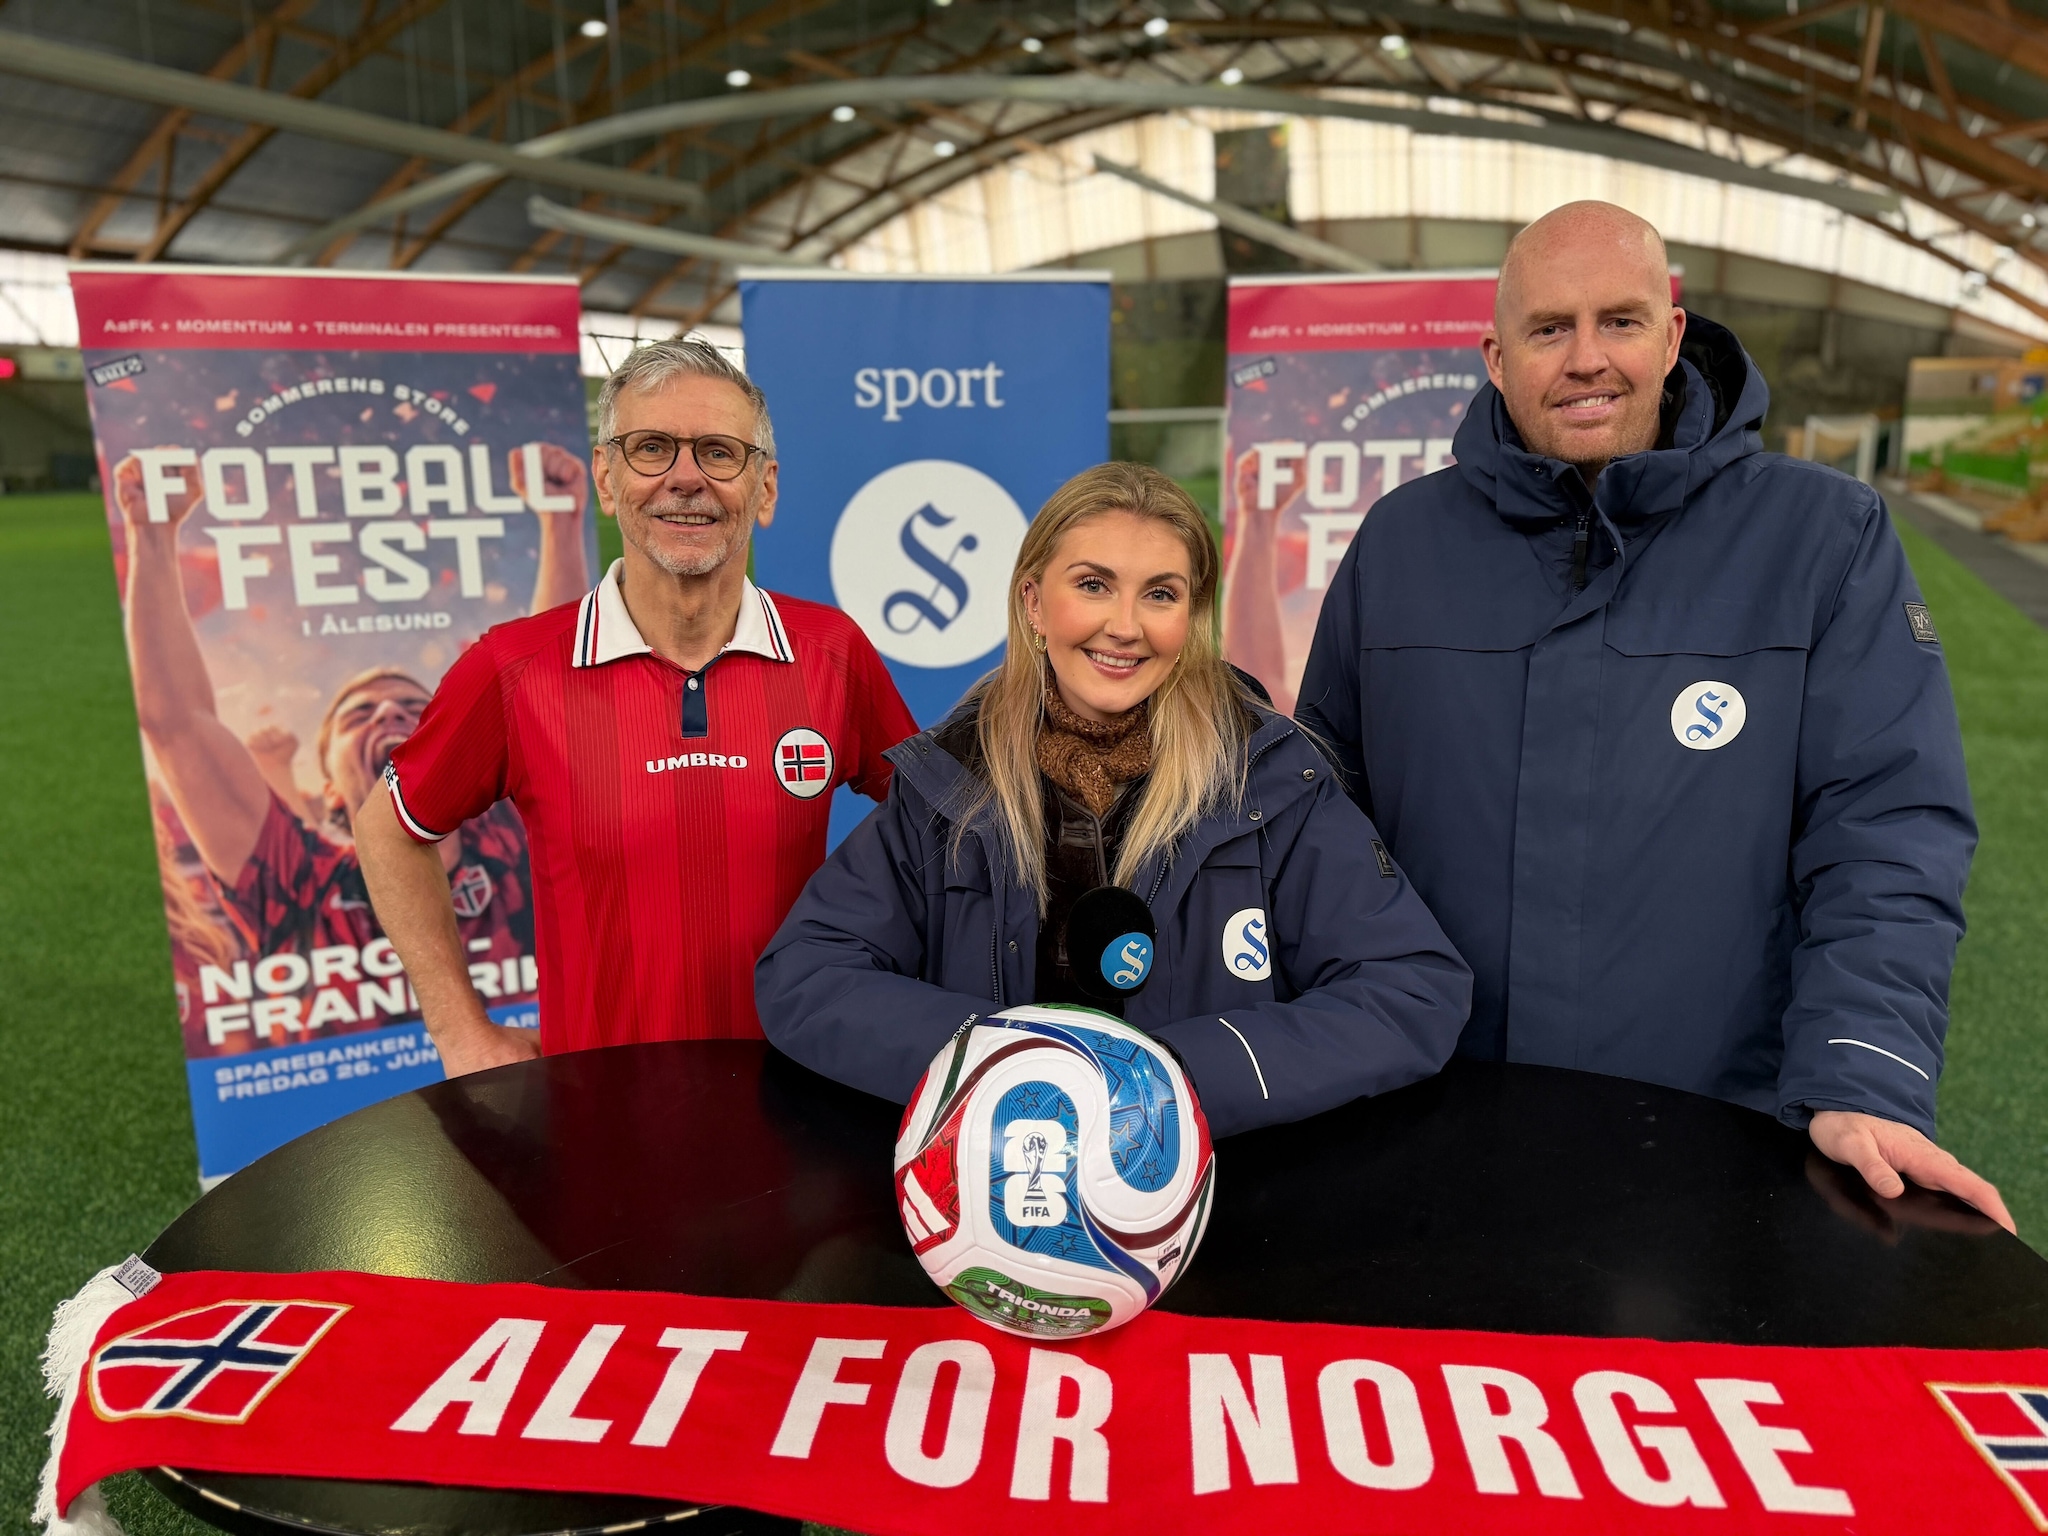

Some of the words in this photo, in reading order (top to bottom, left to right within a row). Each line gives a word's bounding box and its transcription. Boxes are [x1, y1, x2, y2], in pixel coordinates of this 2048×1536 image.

[176, 319, 293, 334] MOMENTIUM
[314, 321, 429, 336] TERMINALEN
[433, 323, 561, 338] PRESENTERER:
[1307, 322, 1406, 337] MOMENTIUM
[236, 377, 385, 438] SOMMERENS
[393, 384, 471, 436] STORE
[854, 360, 1005, 422] sport
[1341, 373, 1478, 432] SOMMERENS
[128, 443, 575, 523] FOTBALL
[1251, 438, 1456, 511] FOT
[204, 518, 504, 611] FEST
[303, 620, 310, 636] I
[321, 611, 452, 636] ÅLESUND
[646, 752, 748, 773] UMBRO
[199, 937, 405, 1004] NORG
[214, 1031, 416, 1086] SPAREBANKEN
[217, 1068, 330, 1101] FREDAG
[336, 1060, 379, 1082] 26.
[1022, 1205, 1050, 1218] FIFA
[985, 1280, 1092, 1317] TRIONDA
[390, 1317, 749, 1448] ALT
[769, 1336, 1114, 1504] FOR
[1187, 1352, 1855, 1517] NORGE
